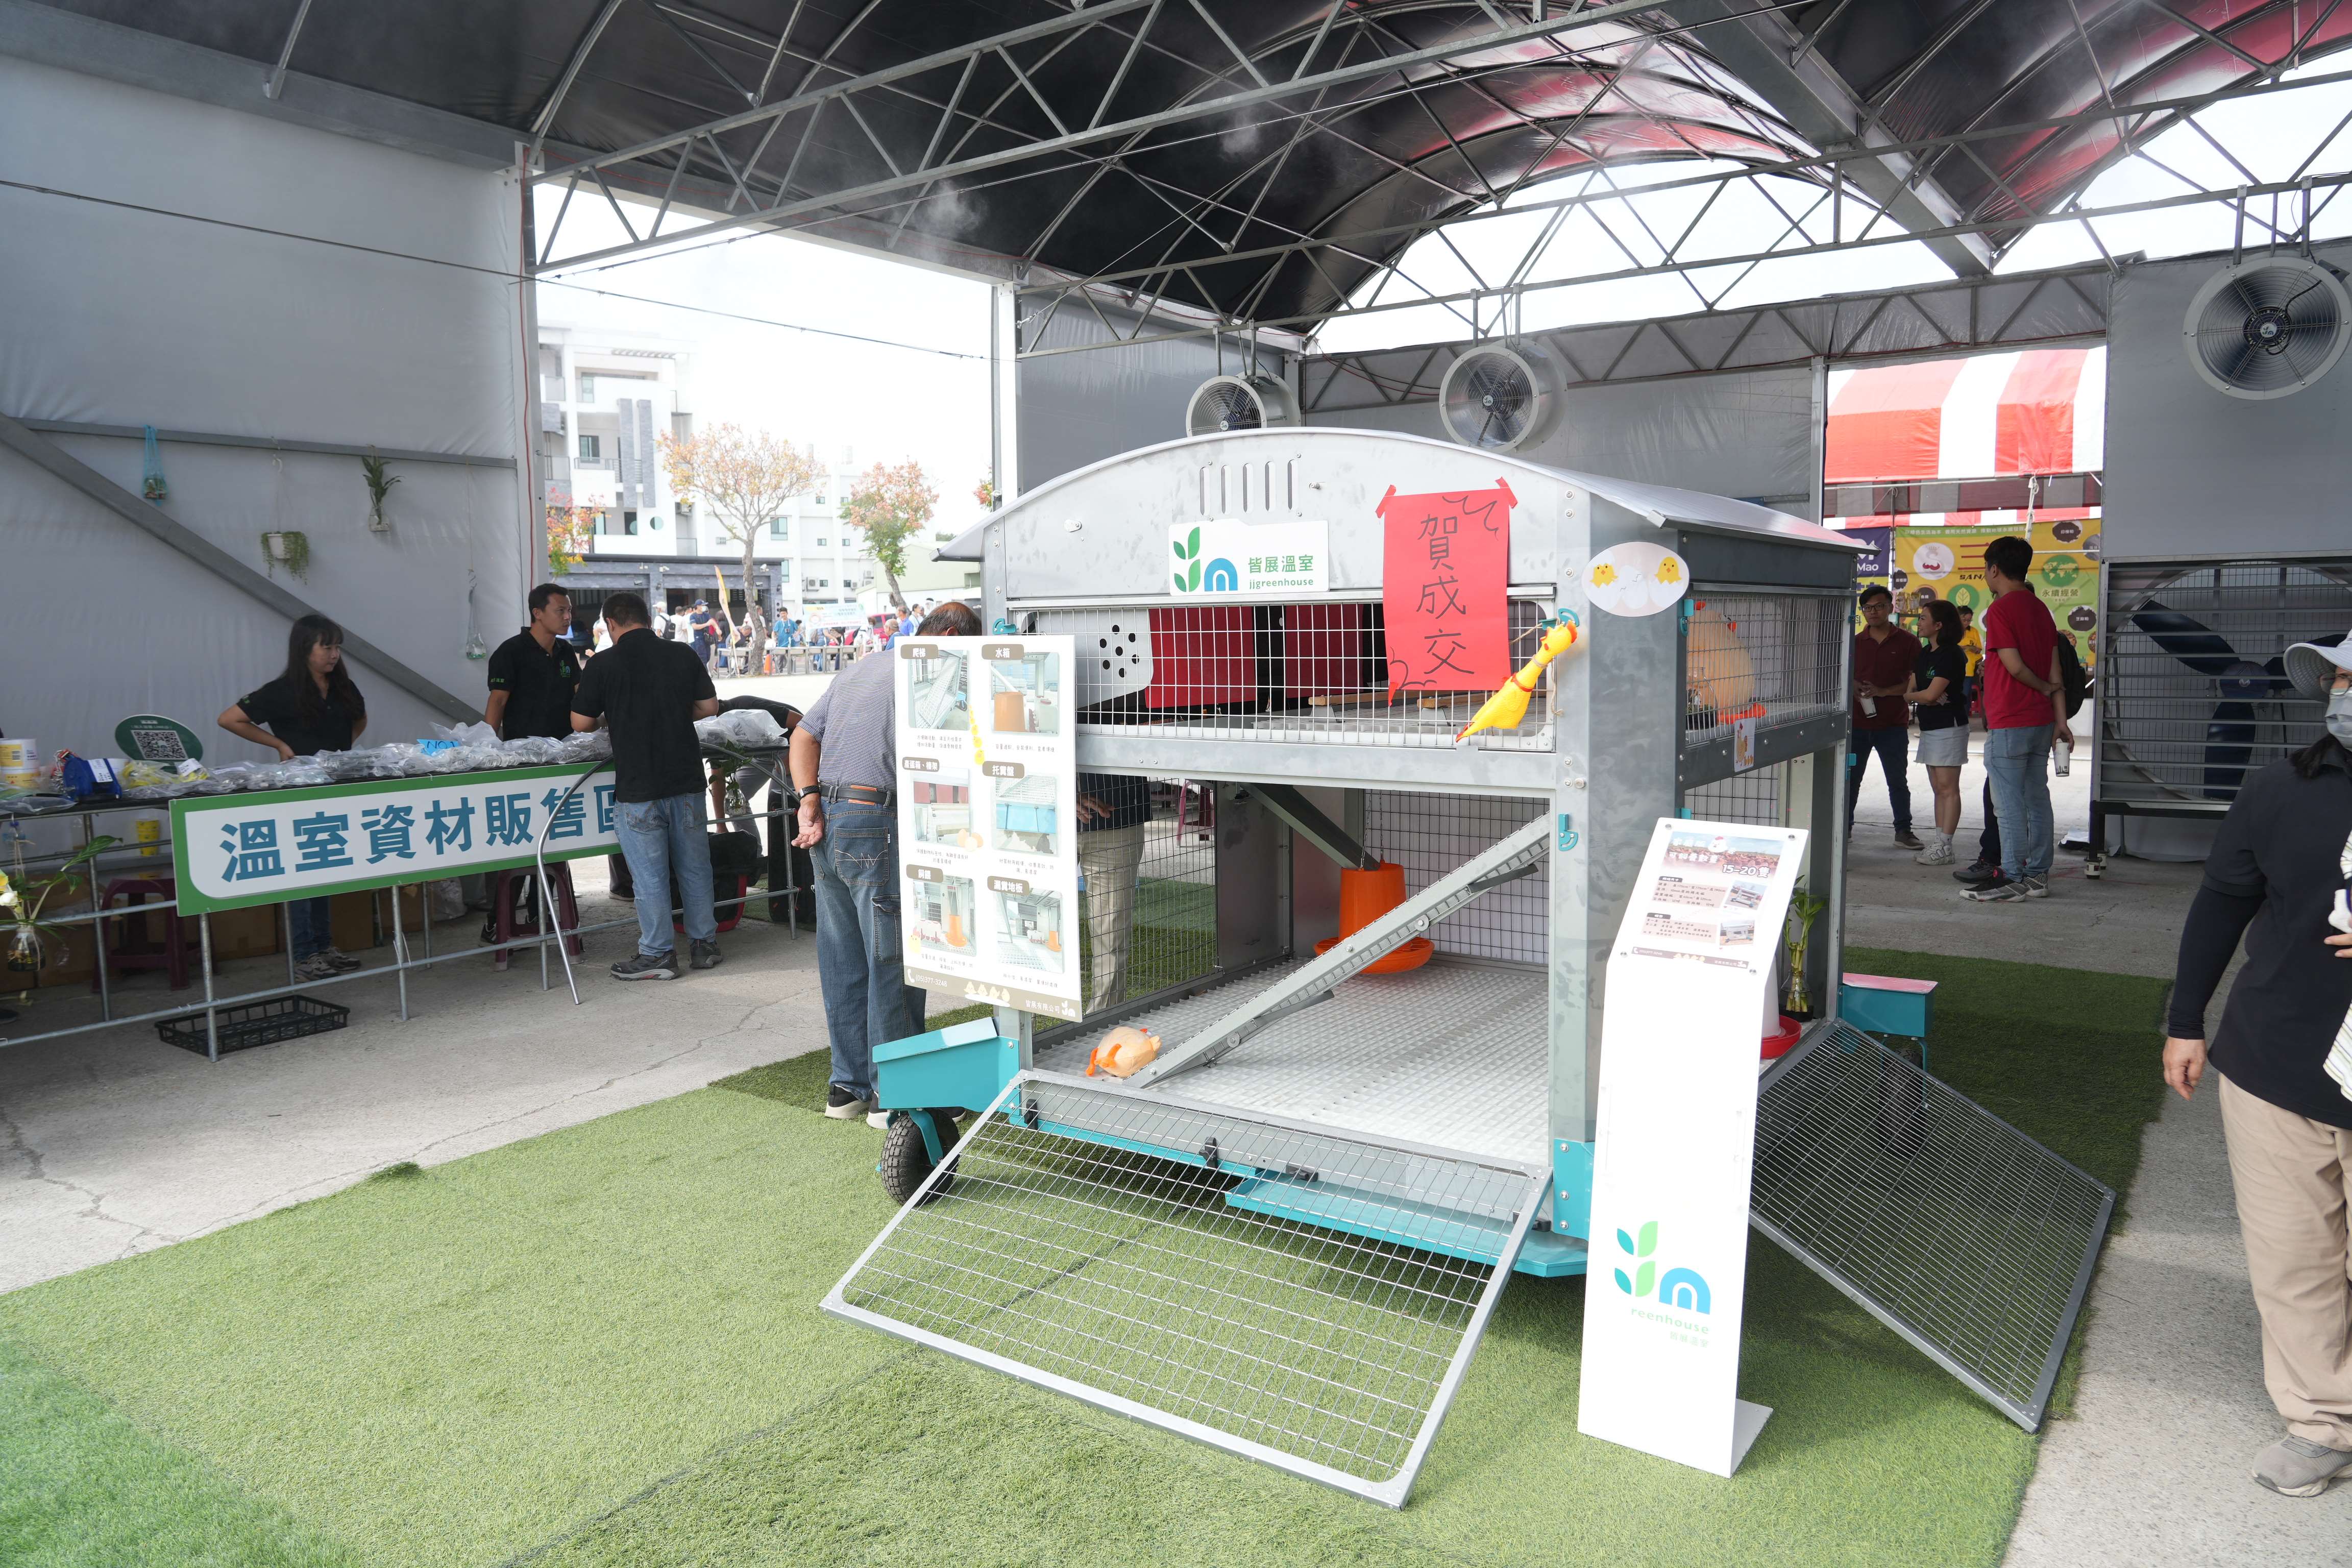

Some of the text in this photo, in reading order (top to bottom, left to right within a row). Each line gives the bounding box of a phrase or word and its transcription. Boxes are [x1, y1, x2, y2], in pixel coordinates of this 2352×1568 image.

[1248, 554, 1313, 574] 皆展溫室
[1249, 578, 1314, 590] jjgreenhouse
[1416, 512, 1475, 675] 賀成交
[2042, 588, 2079, 598] 永續經營
[912, 647, 926, 658] 爬梯
[995, 647, 1010, 658] 水箱
[992, 765, 1015, 776] 托糞盤
[993, 879, 1023, 893] 漏糞地板
[915, 973, 948, 988] (05)377-3248
[1025, 999, 1060, 1014] 皆展有限公司
[1631, 1308, 1709, 1334] reenhouse
[1670, 1331, 1710, 1348] 皆展溫室
